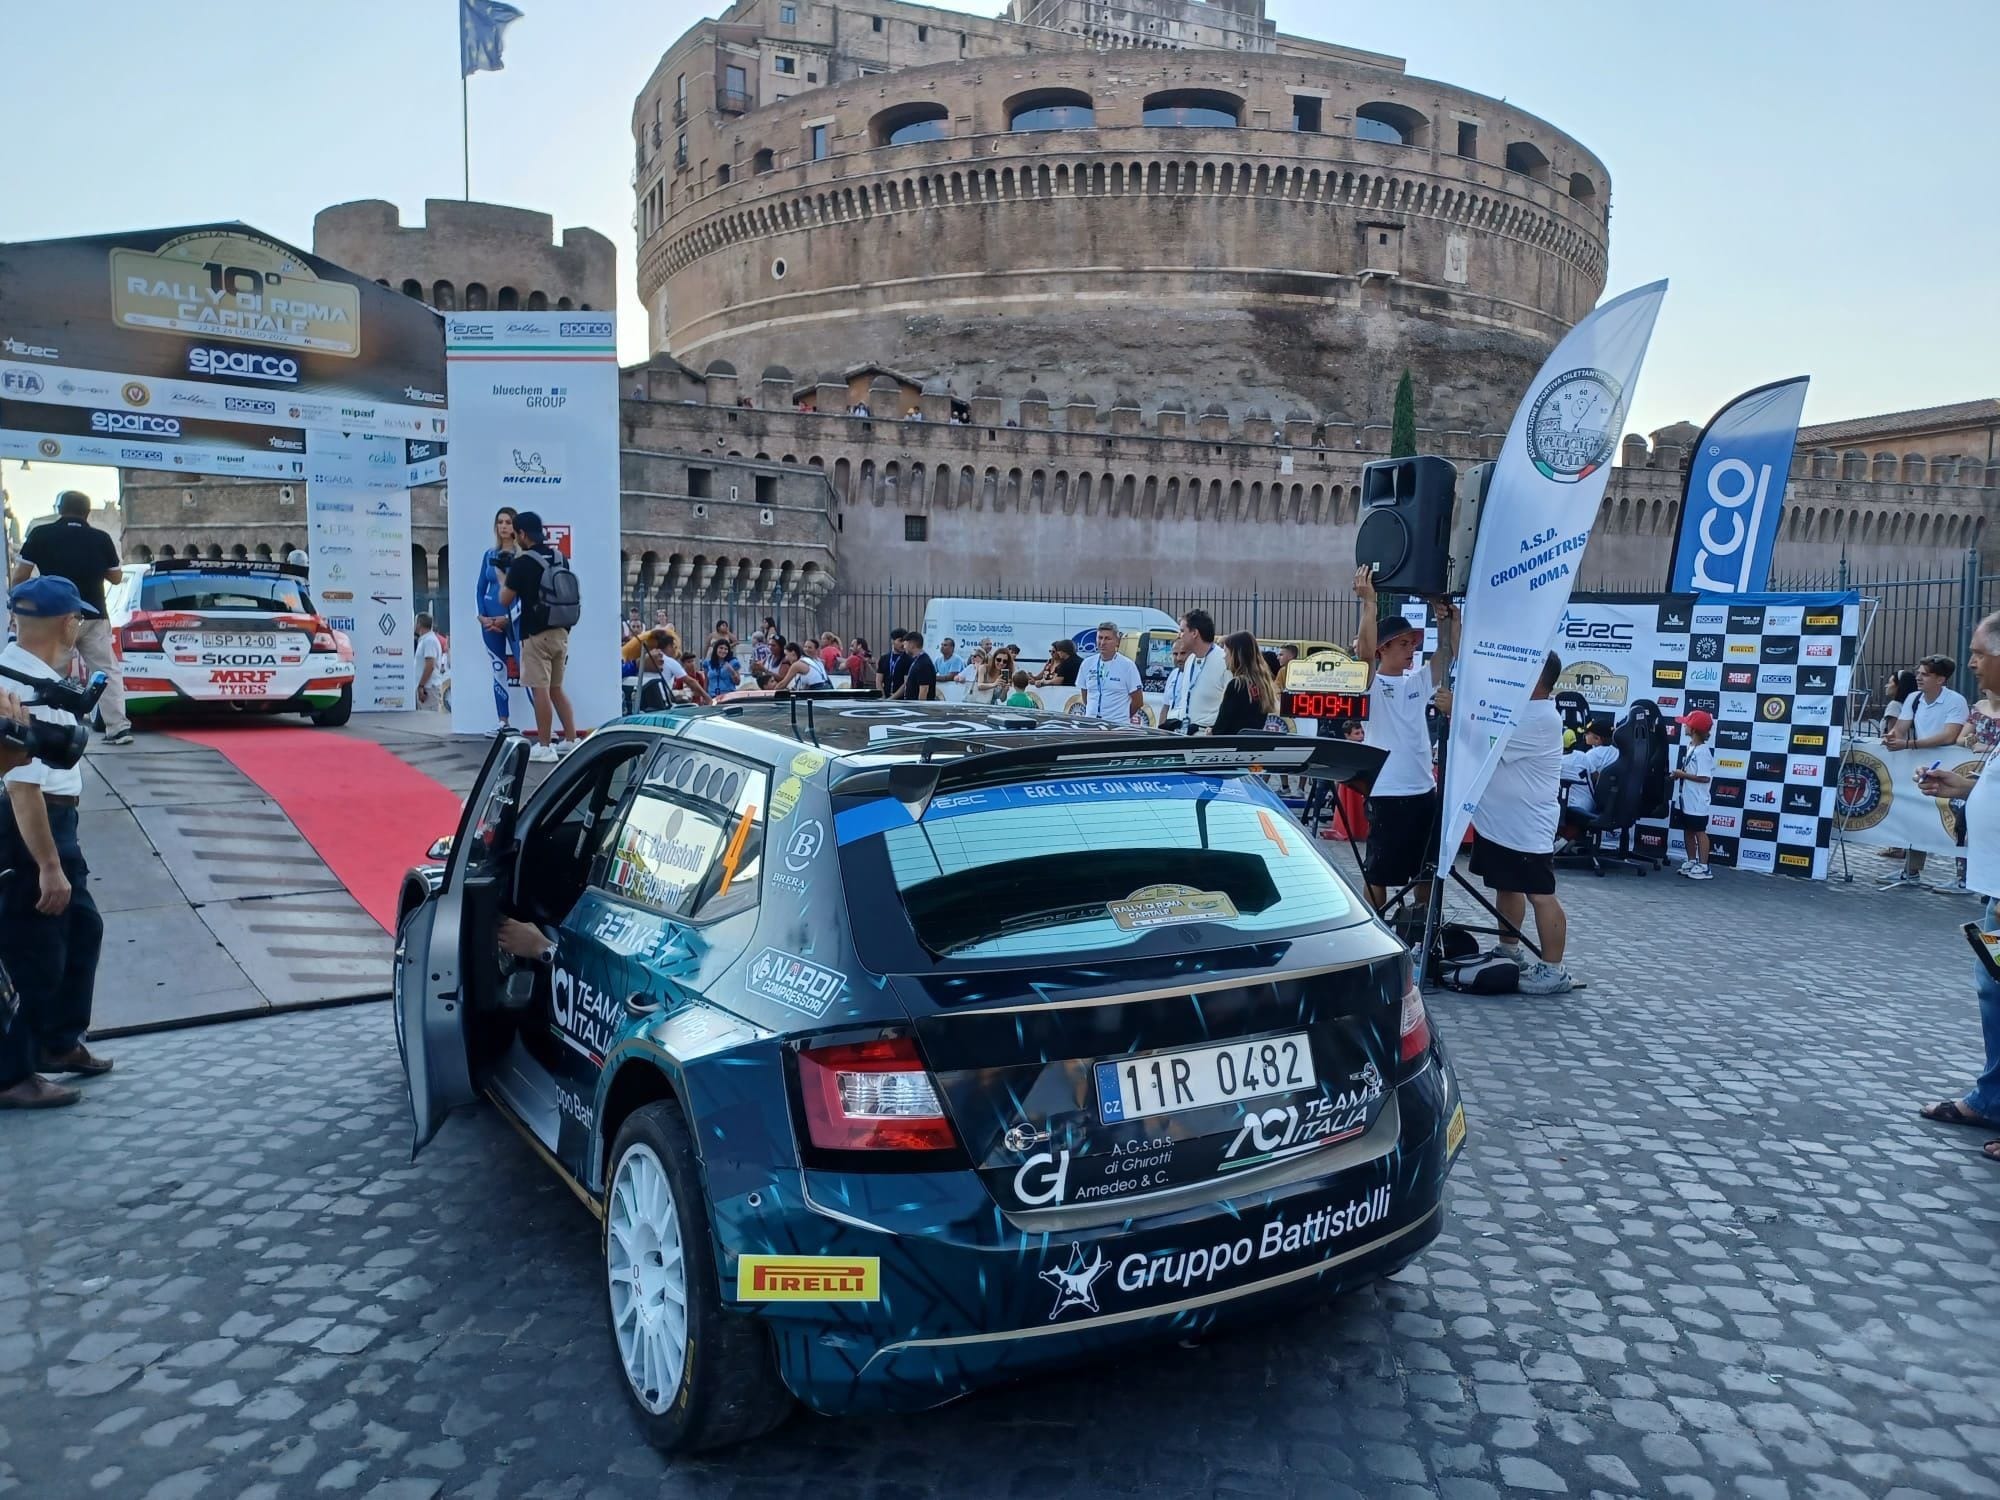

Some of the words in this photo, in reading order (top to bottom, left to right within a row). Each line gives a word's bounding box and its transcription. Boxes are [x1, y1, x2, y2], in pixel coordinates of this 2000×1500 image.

[127, 276, 226, 304] RALLY
[236, 292, 263, 311] DI
[271, 298, 347, 321] ROMA
[178, 303, 309, 333] CAPITALE
[189, 346, 298, 383] sparco
[4, 374, 40, 391] FIA
[492, 384, 543, 396] bluechem
[526, 396, 567, 408] GROUP
[91, 411, 180, 437] sparco
[1527, 407, 1537, 458] ASSOCIAZIONE
[1536, 378, 1562, 407] SPORTIVA
[502, 476, 562, 484] MICHELIN
[1691, 458, 1755, 592] rco
[1519, 527, 1558, 554] A.S.D.
[1529, 563, 1570, 592] ROMA
[215, 635, 234, 647] SP
[240, 635, 274, 648] 12-00
[1566, 623, 1634, 640] ERC
[202, 653, 277, 665] ŠKODA
[209, 670, 277, 684] MRF
[1594, 685, 1623, 694] ROMA
[219, 684, 267, 696] TYRES
[1697, 699, 1715, 708] EPS
[1108, 757, 1177, 768] DELTA
[1191, 754, 1264, 764] RALLY
[1858, 754, 1882, 770] 2022
[1024, 784, 1060, 799] ERC
[1062, 782, 1103, 798] LIVE
[1105, 781, 1126, 795] ON
[1127, 779, 1173, 794] WRC+
[772, 872, 806, 890] BRERA
[1113, 902, 1144, 914] RALLY
[1157, 900, 1185, 909] ROMA
[769, 958, 839, 1001] NARDI
[577, 979, 619, 1025] TEAM
[762, 980, 824, 1013] COMPRESSORI
[1126, 1057, 1195, 1112] 11R
[1216, 1042, 1303, 1097] 0482
[1104, 1101, 1121, 1114] CZ
[1305, 1089, 1368, 1120] TEAM
[1294, 1105, 1368, 1145] ITALIA
[1104, 1160, 1119, 1175] di
[1122, 1150, 1173, 1172] Ghirotti
[1075, 1179, 1137, 1200] Amedeo
[1141, 1174, 1151, 1187] &
[1155, 1170, 1169, 1183] C.
[1117, 1236, 1253, 1292] Gruppo
[1259, 1184, 1392, 1254] Battistolli
[753, 1265, 865, 1291] PIRELLI
